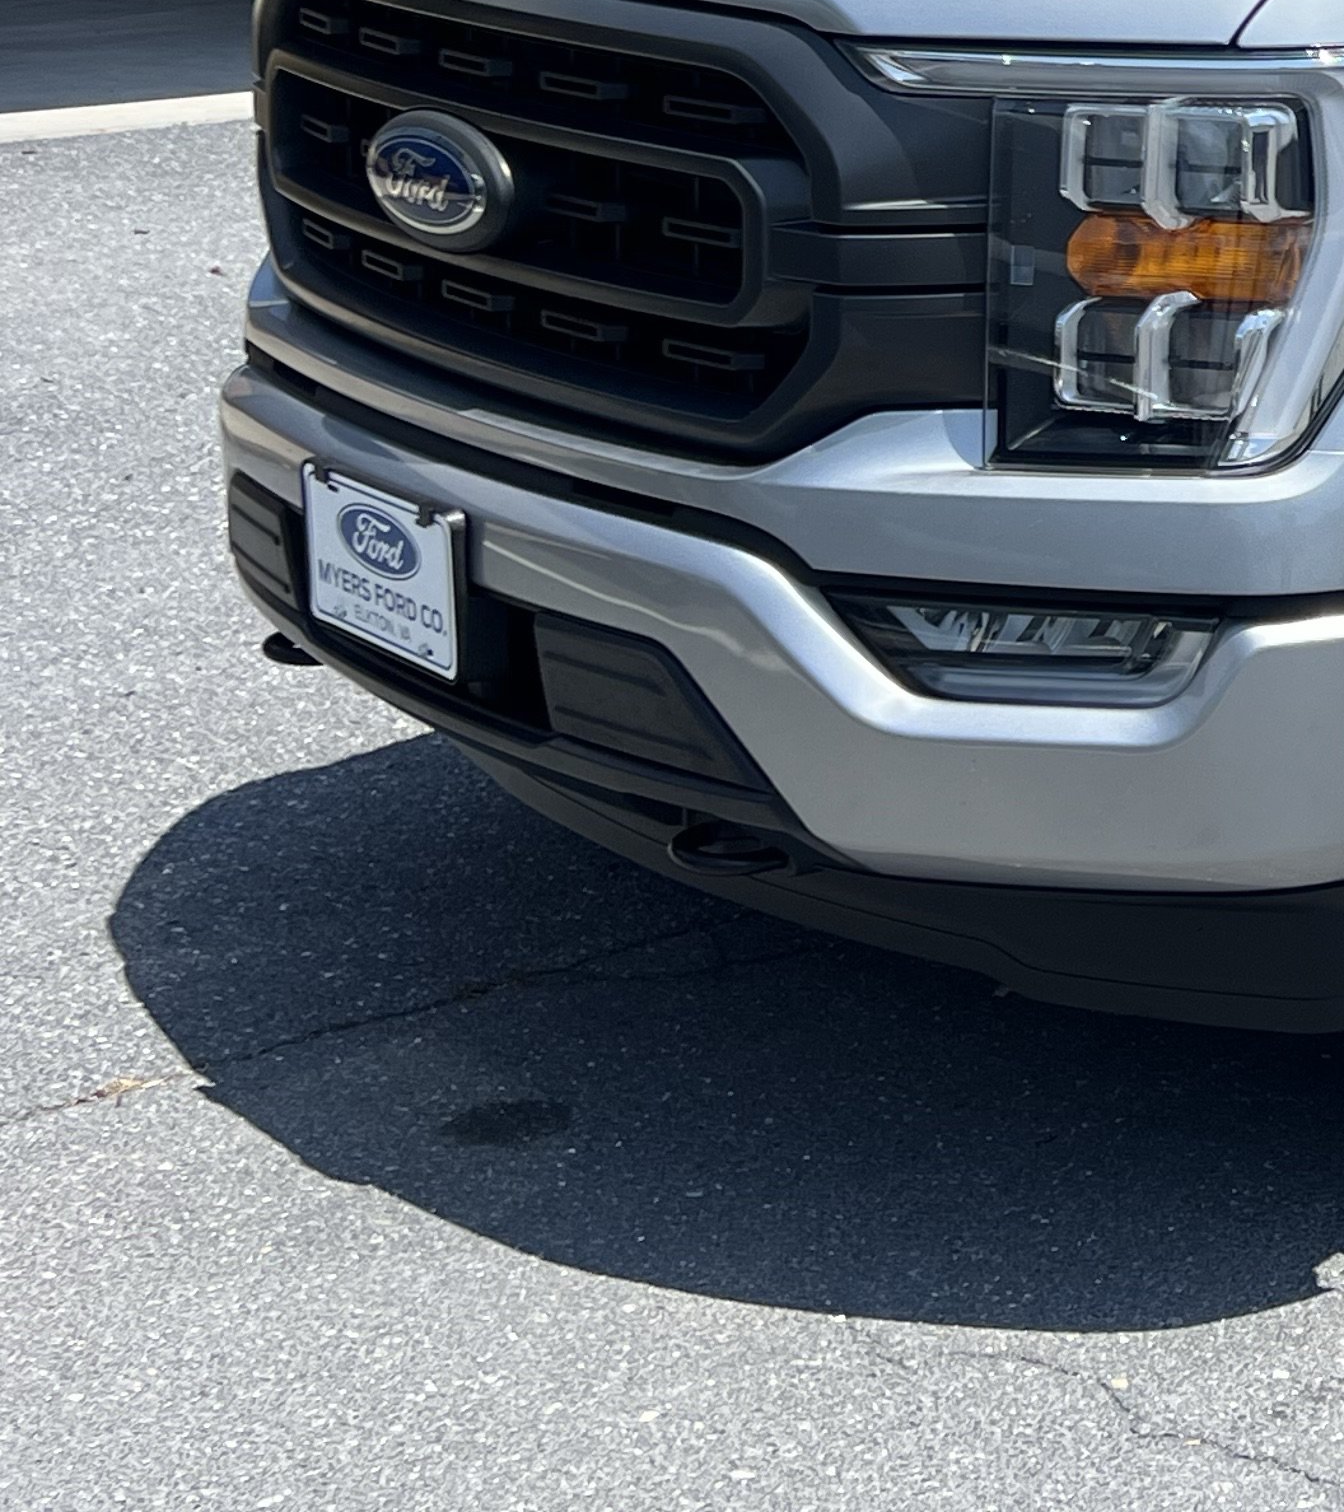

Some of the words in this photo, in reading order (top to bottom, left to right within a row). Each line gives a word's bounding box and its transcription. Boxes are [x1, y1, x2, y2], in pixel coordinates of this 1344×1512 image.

[386, 148, 450, 212] Ford
[352, 512, 405, 570] Ford
[318, 559, 372, 602] MYERS
[374, 583, 417, 622] FORD
[420, 604, 447, 636] CO.
